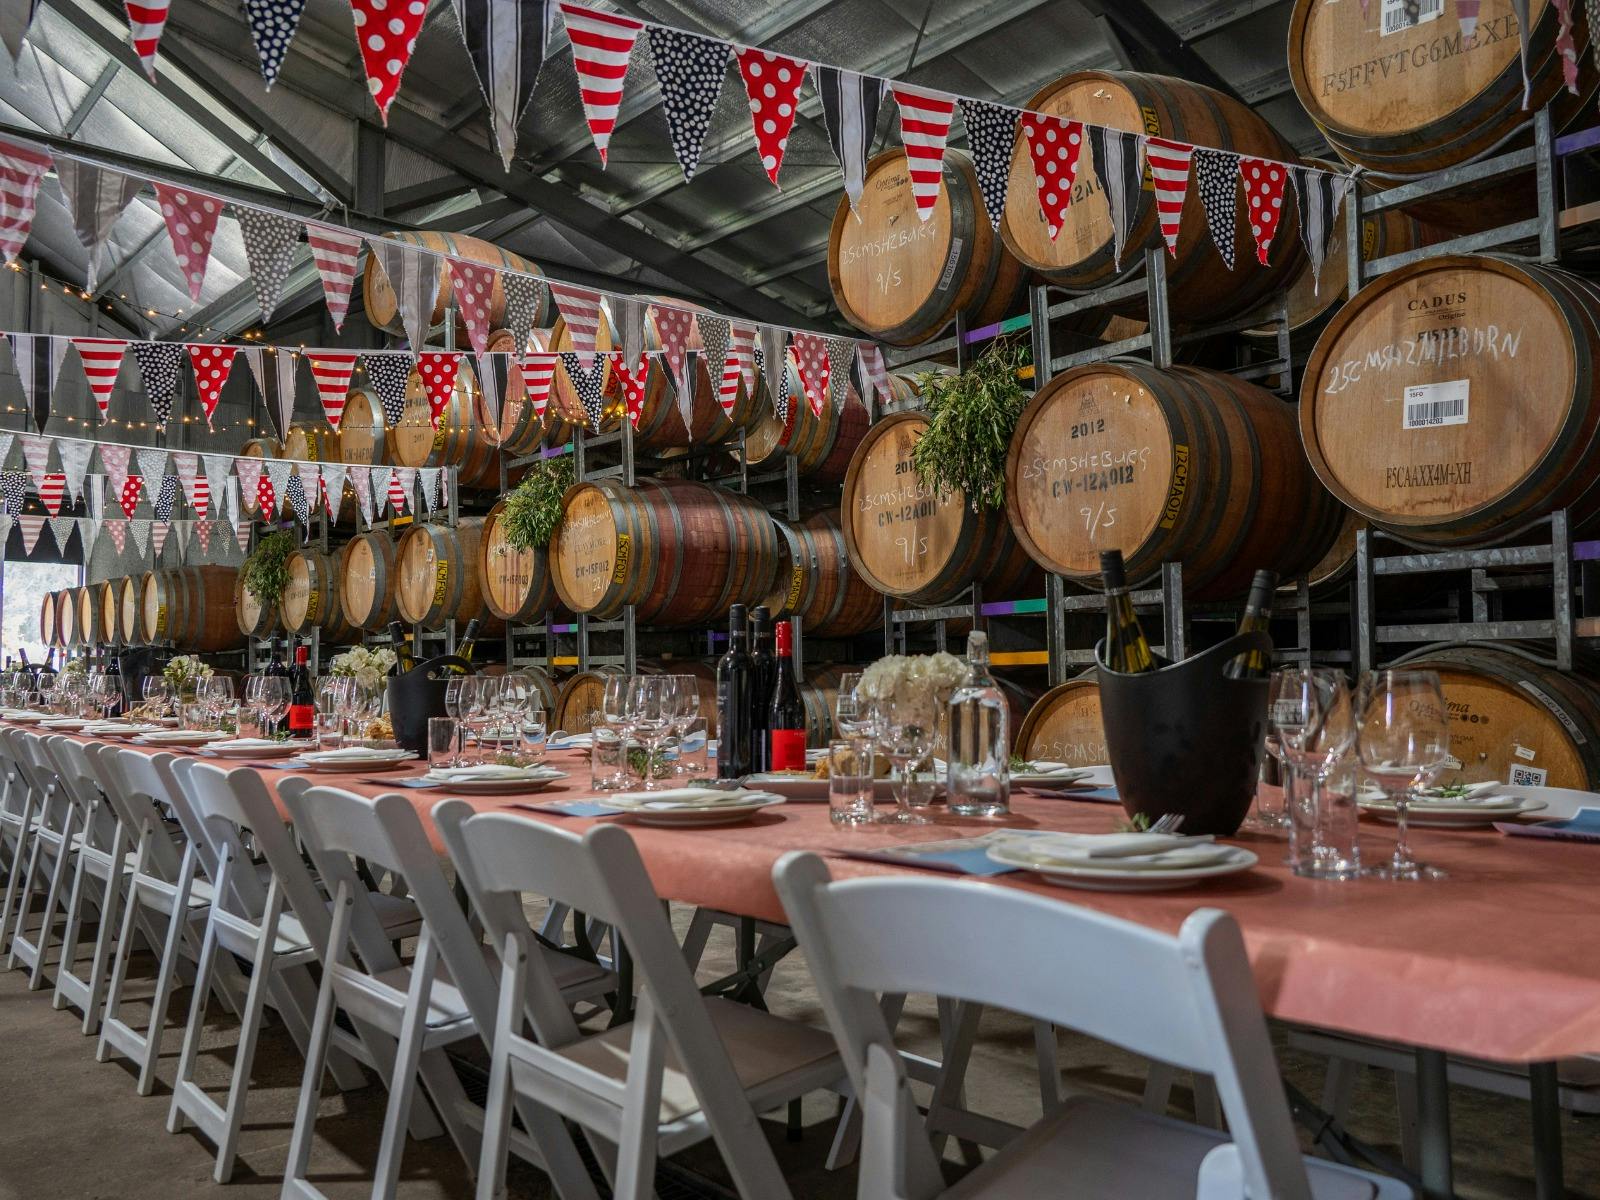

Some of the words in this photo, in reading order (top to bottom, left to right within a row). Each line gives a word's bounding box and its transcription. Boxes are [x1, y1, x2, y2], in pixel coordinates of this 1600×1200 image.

[876, 263, 903, 296] 9/5
[1408, 292, 1466, 311] CADUS
[1071, 418, 1105, 439] 2012
[895, 459, 917, 475] 201
[1080, 501, 1118, 544] 9/5
[895, 524, 928, 567] 9/5
